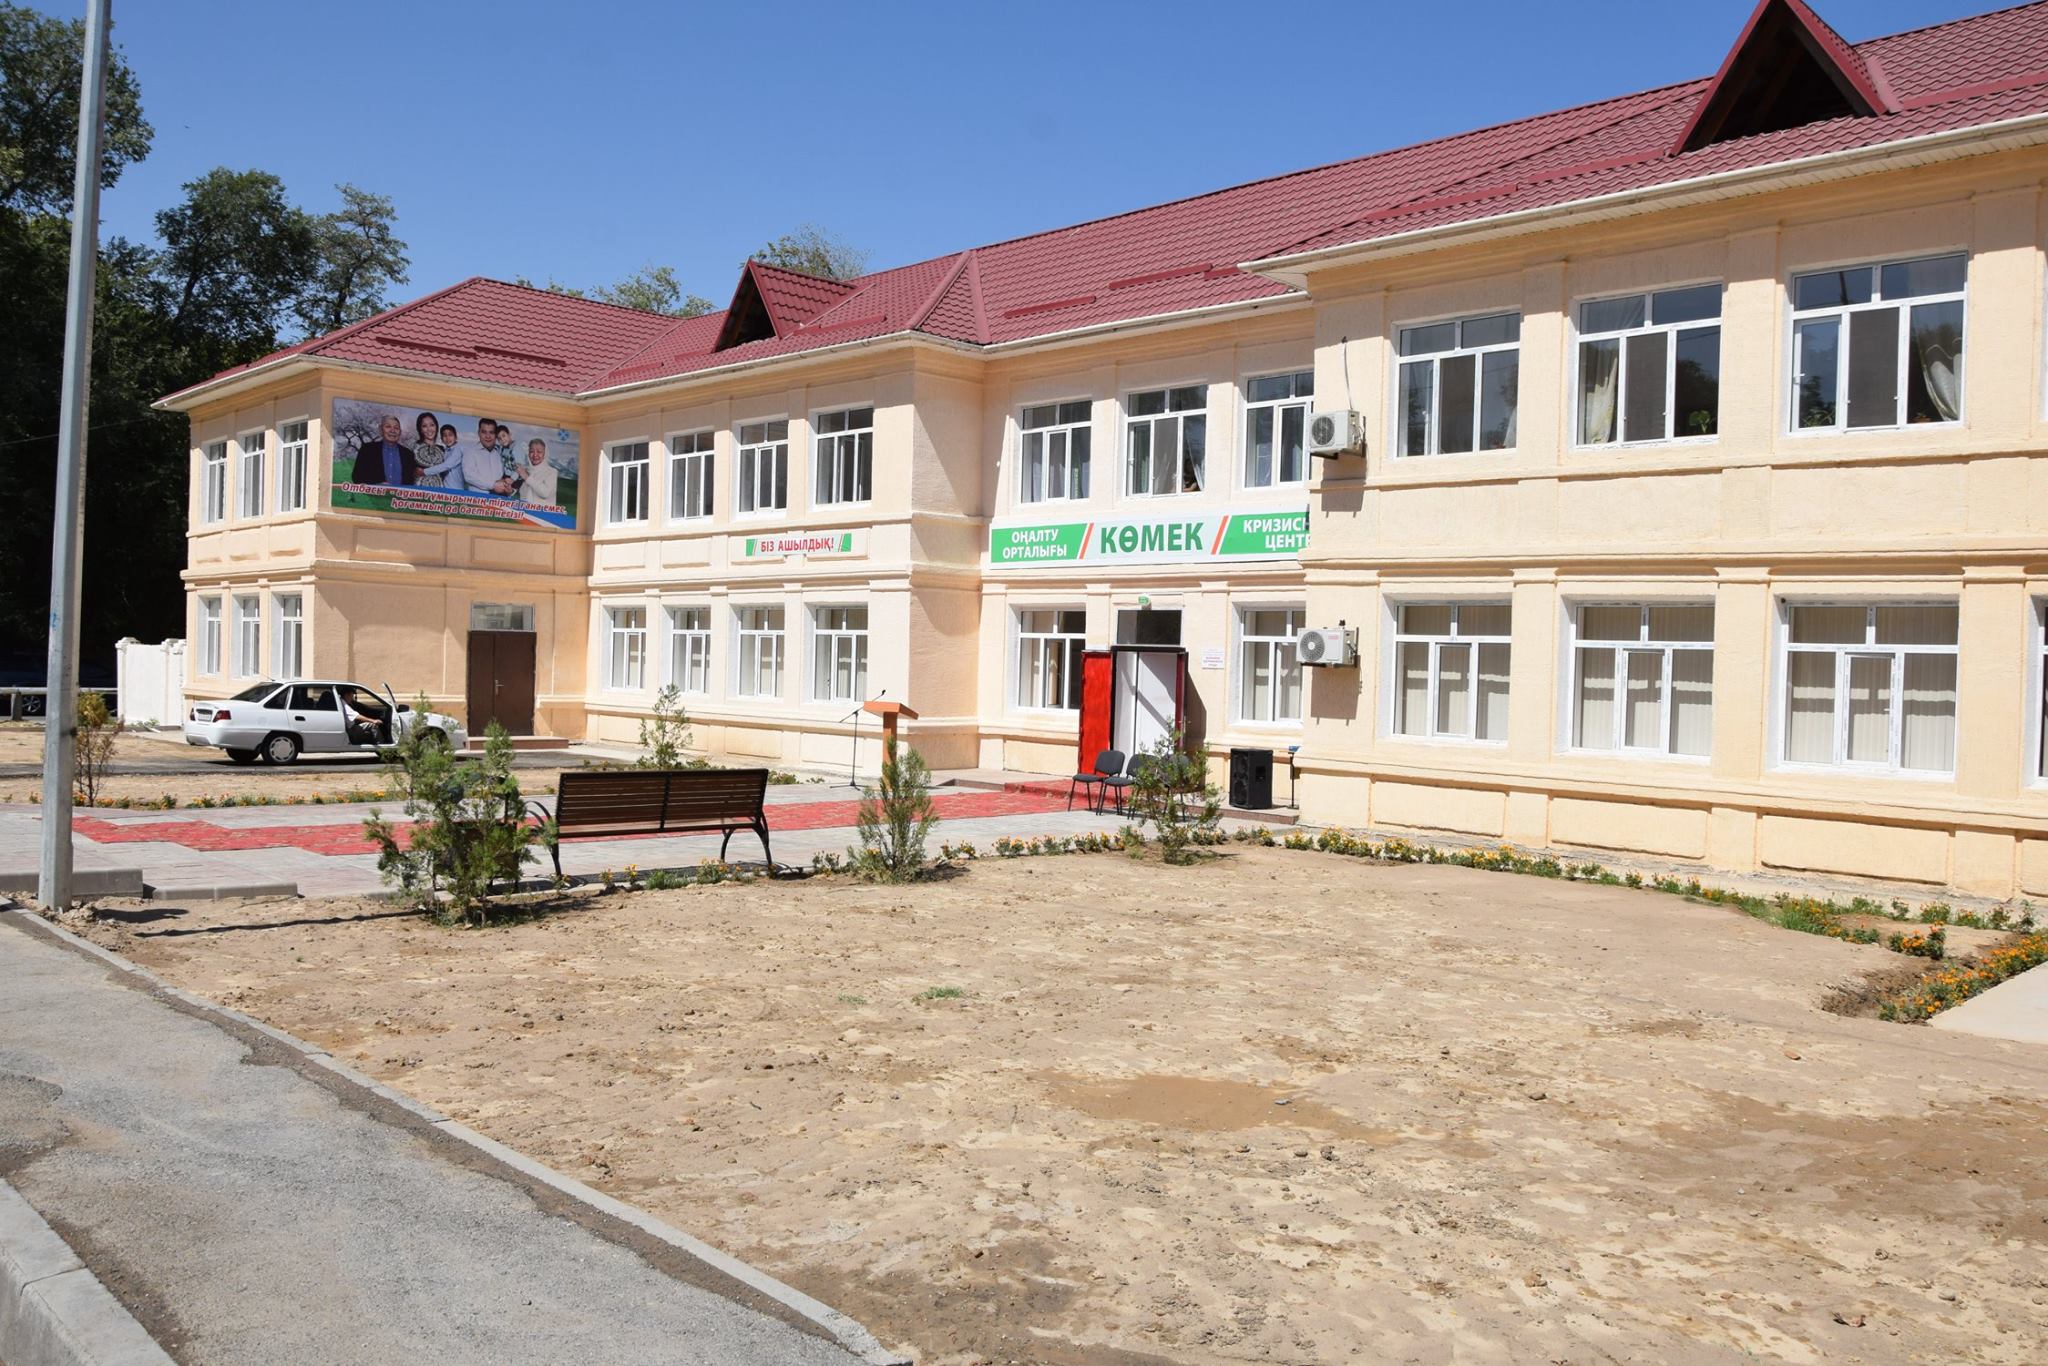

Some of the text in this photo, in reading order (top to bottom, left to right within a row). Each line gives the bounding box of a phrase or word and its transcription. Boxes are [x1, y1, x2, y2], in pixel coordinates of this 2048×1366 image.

[342, 482, 385, 495] Отбасы
[397, 489, 423, 498] адам
[445, 505, 458, 514] да
[460, 505, 493, 517] басты
[761, 537, 834, 552] БІЗ АШЫЛДЫҚ!
[1012, 529, 1058, 545] ОҢАЛТУ
[1101, 523, 1204, 554] КӨМЕК
[1003, 544, 1067, 559] ОРТАЛЫҒЫ
